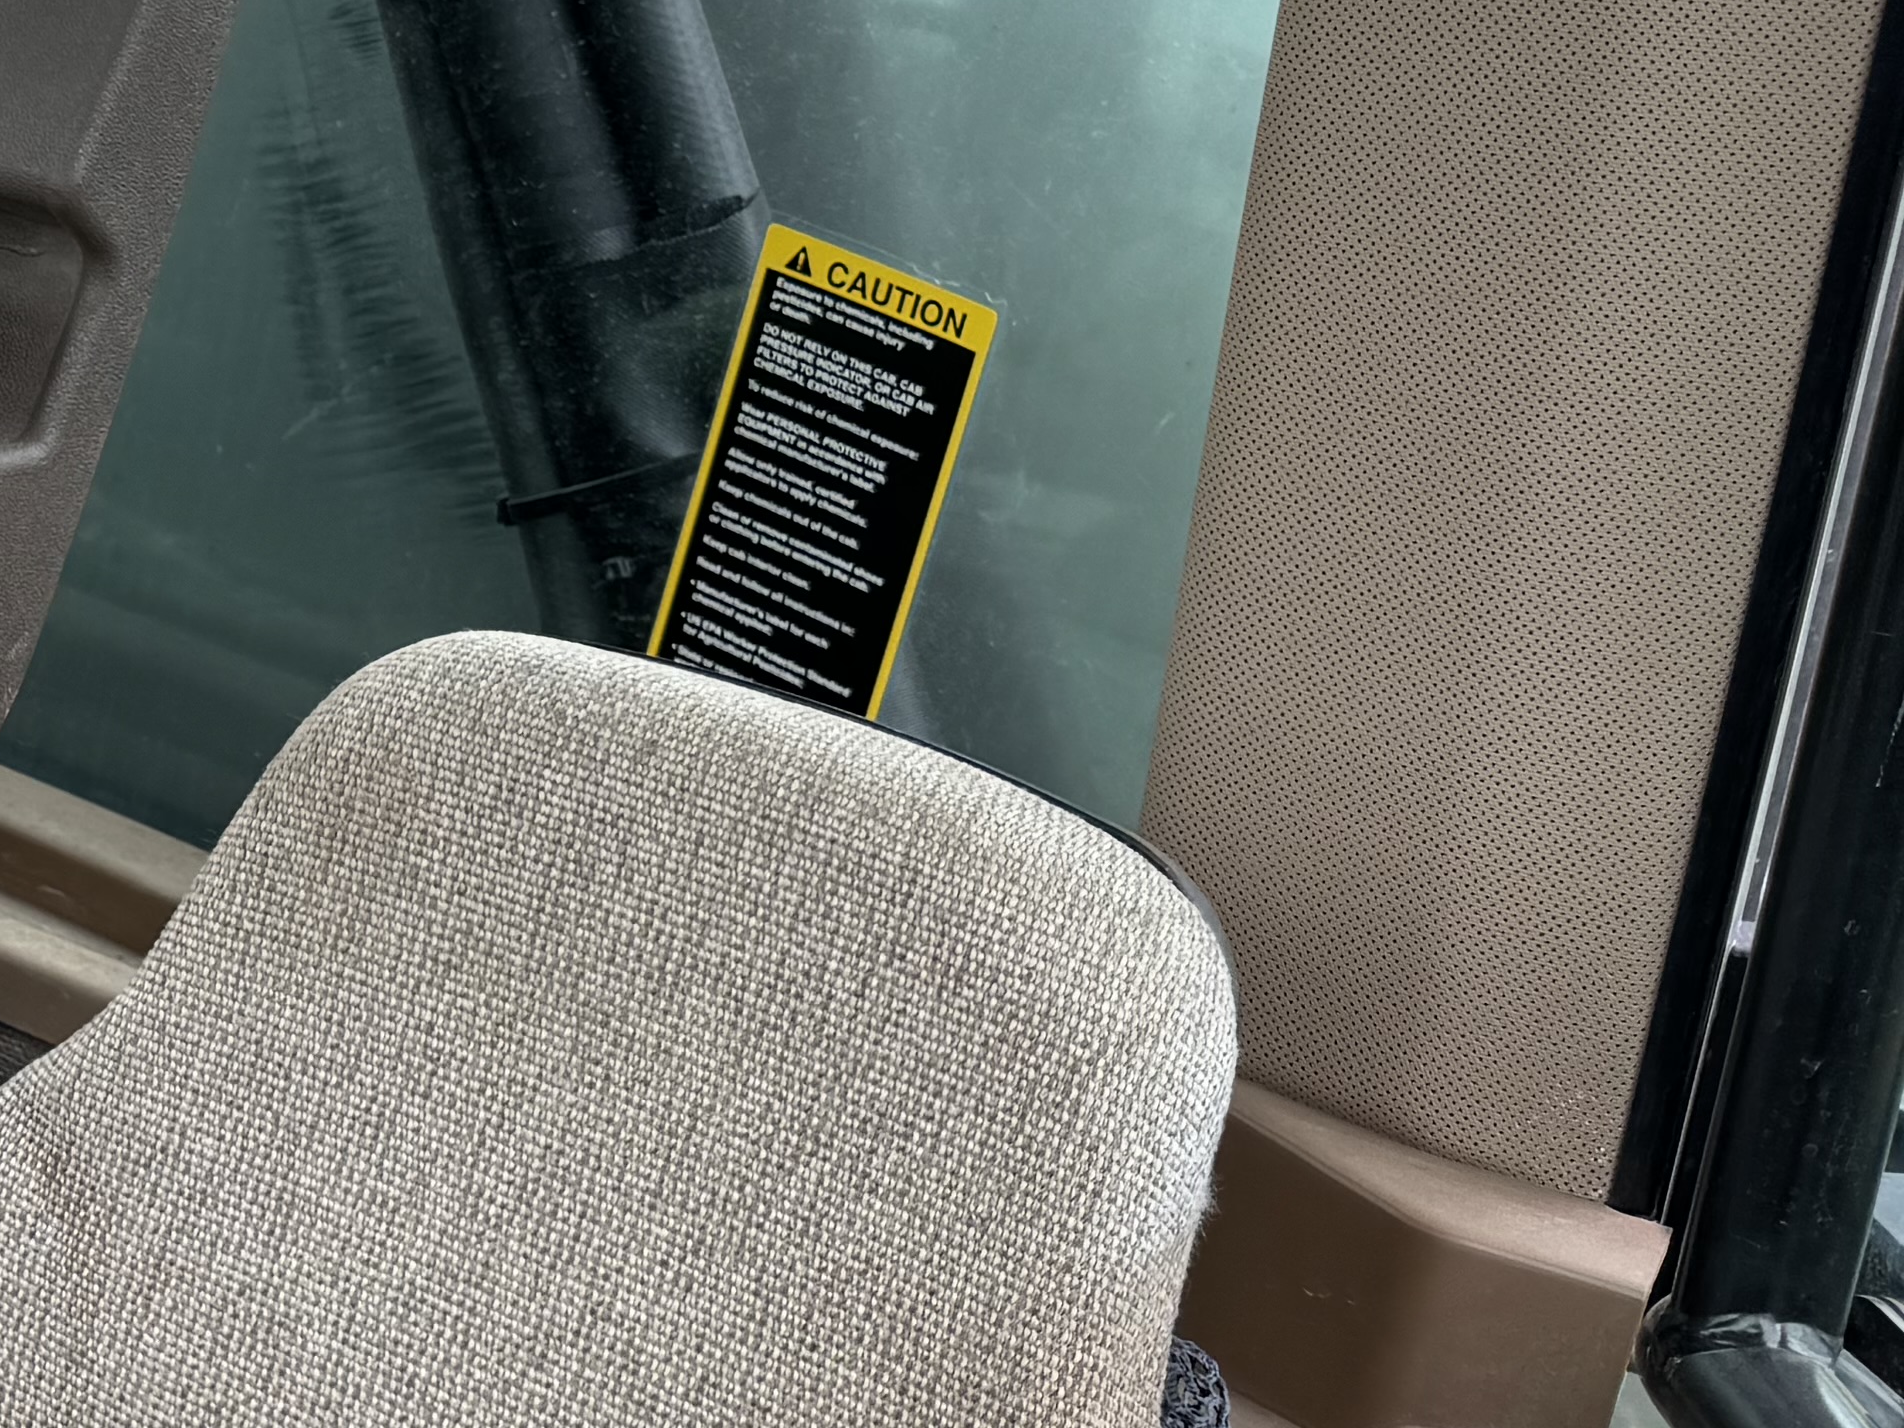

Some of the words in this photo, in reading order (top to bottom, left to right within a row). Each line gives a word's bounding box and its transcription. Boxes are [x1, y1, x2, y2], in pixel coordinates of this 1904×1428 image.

[827, 261, 967, 339] CAUTION
[753, 356, 804, 386] CHEMICAL
[756, 345, 798, 370] FILTERS
[800, 362, 814, 376] TO
[814, 369, 864, 396] PROTECT
[863, 390, 910, 417] AGAINST
[759, 334, 815, 364] PRESSURE
[874, 381, 891, 396] OR
[891, 389, 915, 406] CAB
[915, 399, 934, 415] AIR
[763, 322, 780, 336] DO
[780, 329, 803, 345] NOT
[803, 338, 831, 357] RELY
[831, 350, 848, 364] ON
[849, 357, 872, 375] THIS
[899, 379, 923, 396] CAB
[741, 401, 765, 419] Wear
[766, 412, 820, 444] PERSONAL
